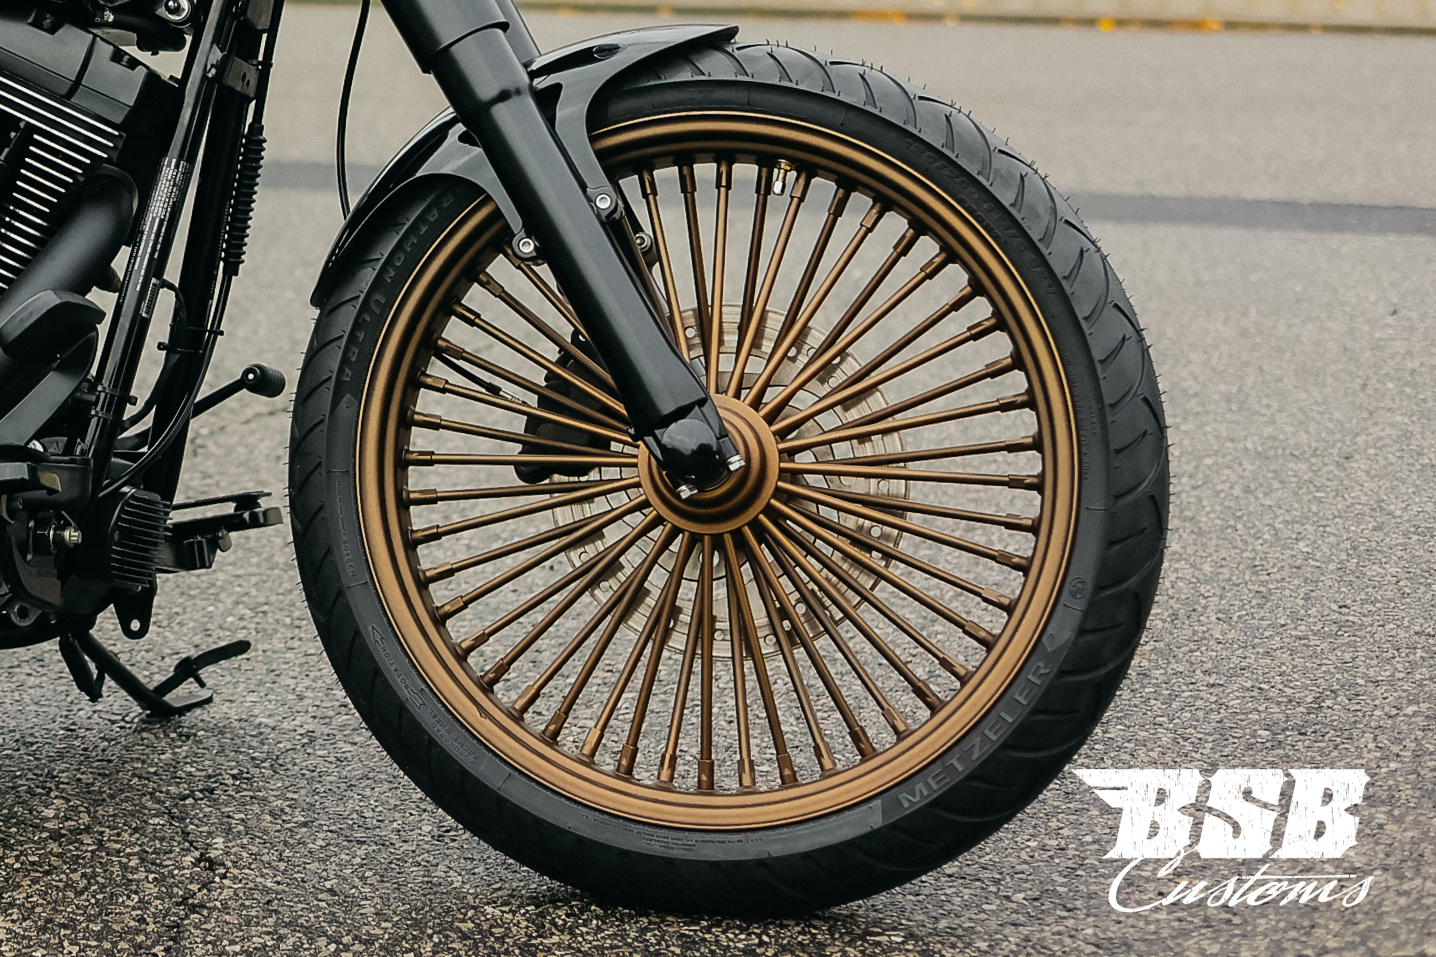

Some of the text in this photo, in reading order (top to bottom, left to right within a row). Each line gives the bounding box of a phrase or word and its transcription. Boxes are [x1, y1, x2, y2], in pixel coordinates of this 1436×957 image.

[341, 292, 386, 382] ULTRA
[380, 646, 411, 690] ROTATION
[897, 661, 1051, 809] METZELER
